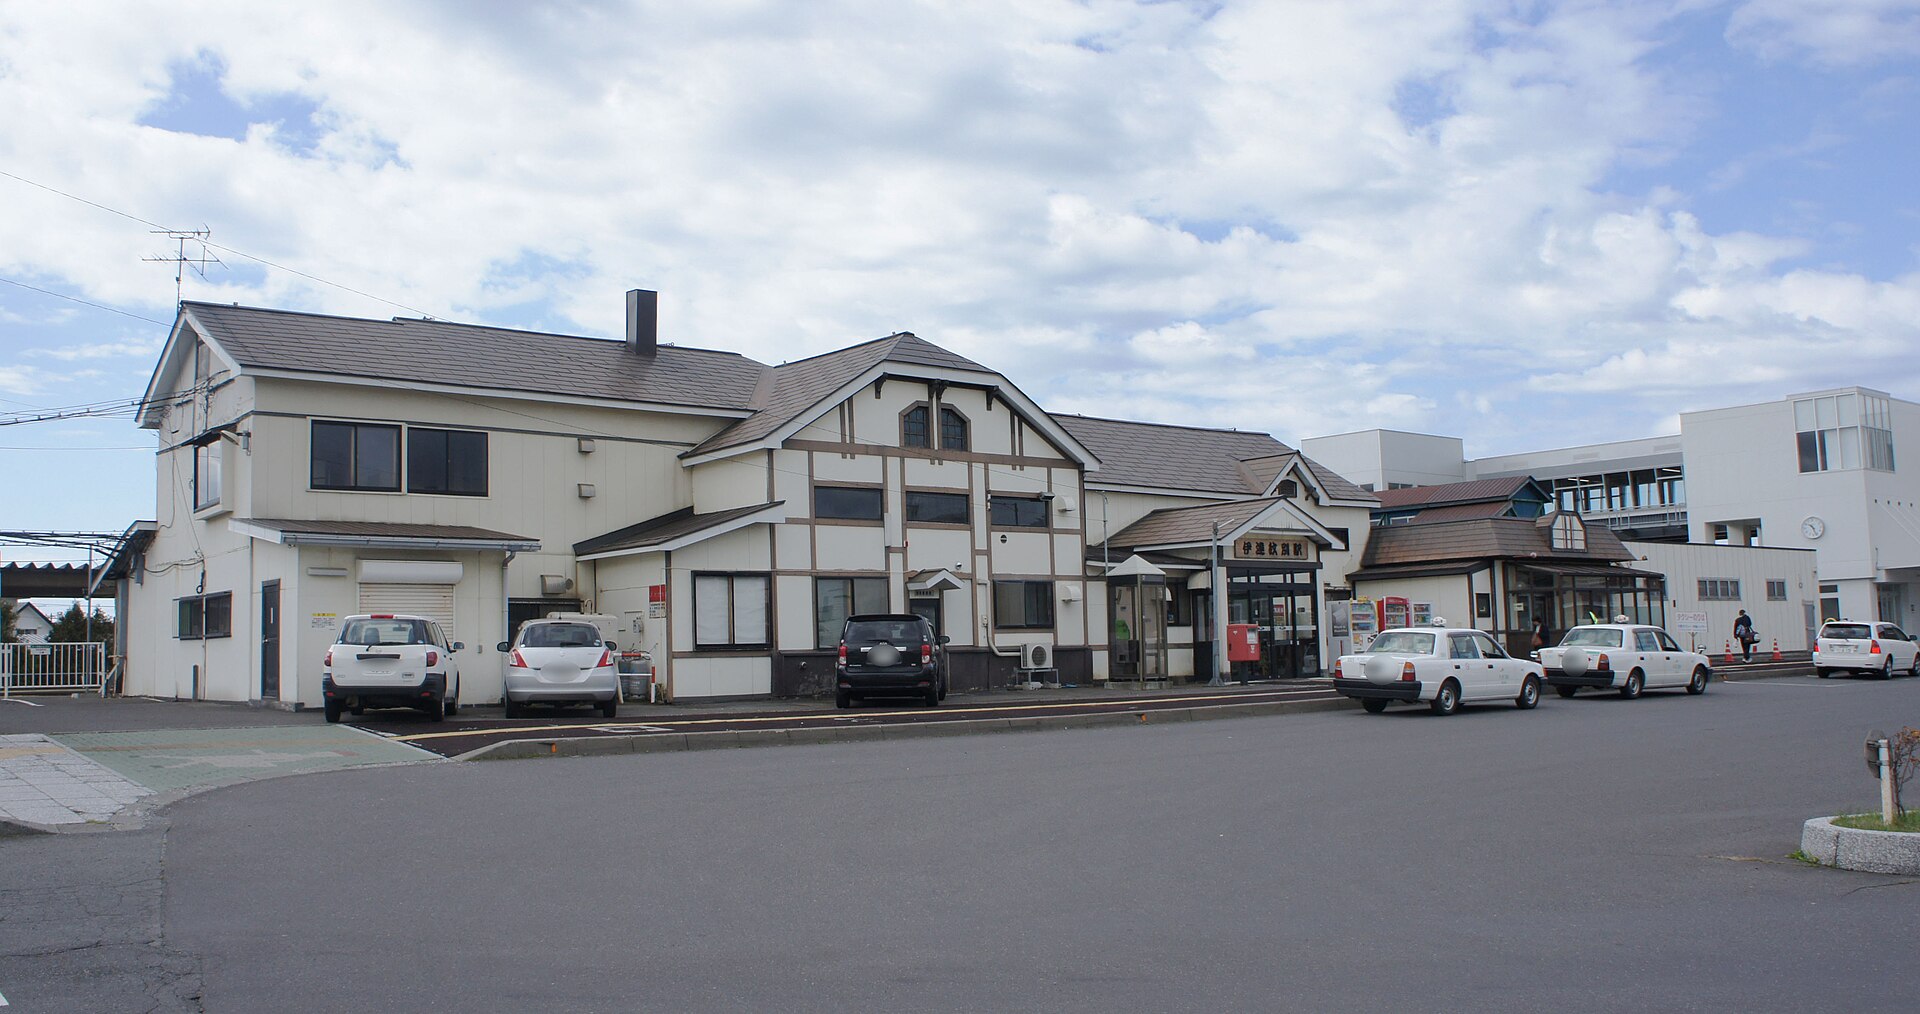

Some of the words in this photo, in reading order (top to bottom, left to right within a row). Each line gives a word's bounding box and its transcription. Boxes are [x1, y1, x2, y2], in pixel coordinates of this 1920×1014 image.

[1242, 541, 1303, 556] 伊達紋別駅
